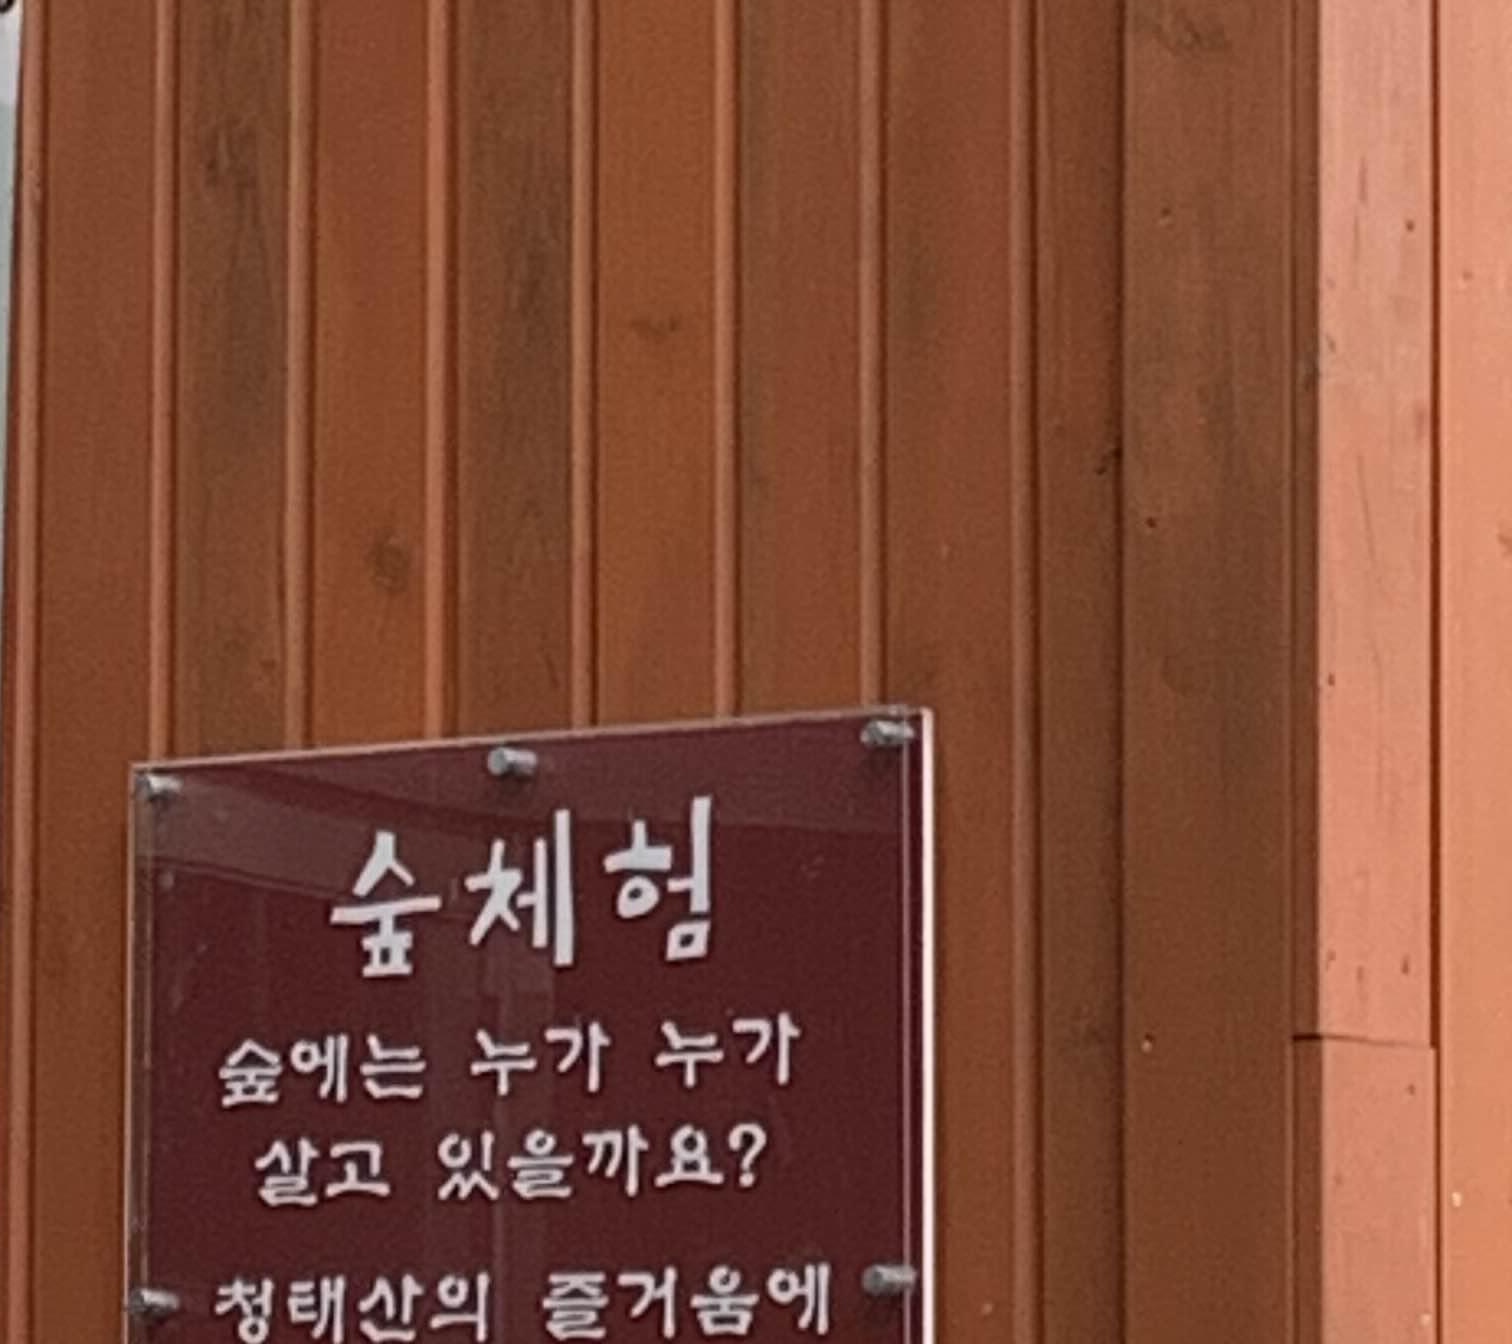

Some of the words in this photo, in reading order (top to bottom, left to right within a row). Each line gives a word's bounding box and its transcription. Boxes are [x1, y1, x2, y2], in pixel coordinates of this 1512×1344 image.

[218, 1033, 427, 1107] 숲에는
[470, 1021, 611, 1096] 누가
[655, 1011, 801, 1088] 누가
[254, 1137, 391, 1207] 살고
[437, 1122, 767, 1203] 있을까요?
[541, 1262, 831, 1341] 즐거움에
